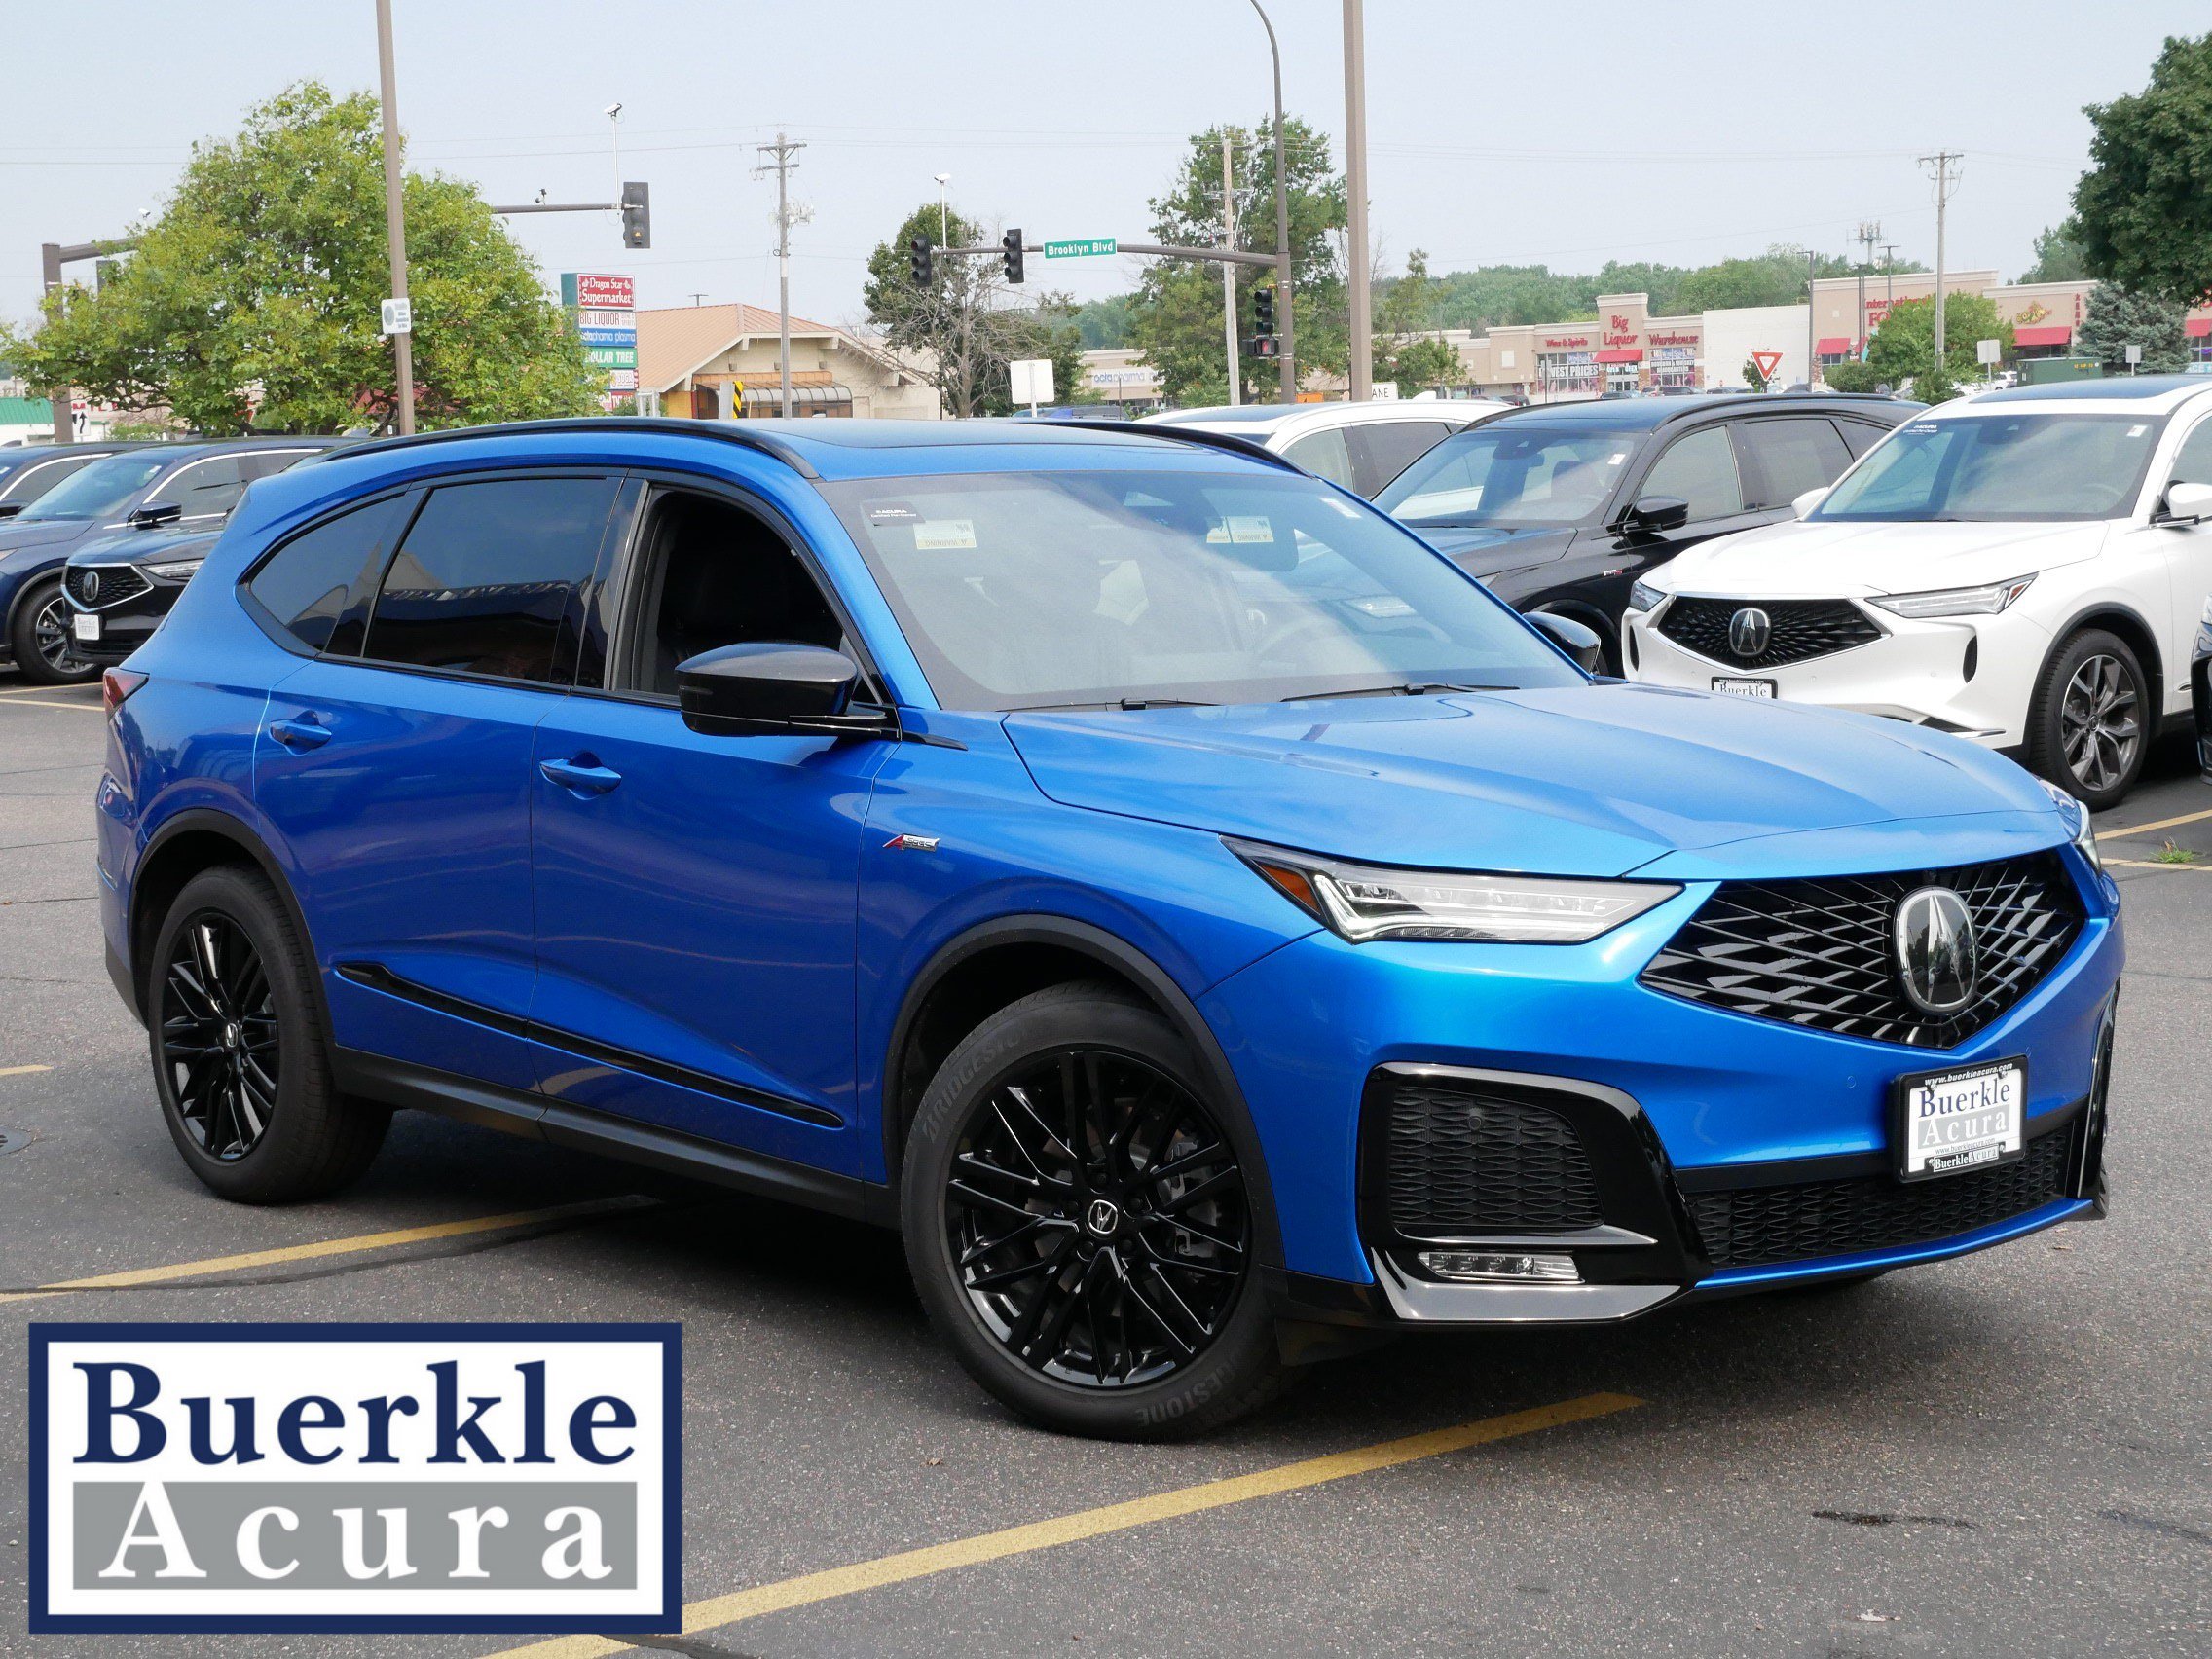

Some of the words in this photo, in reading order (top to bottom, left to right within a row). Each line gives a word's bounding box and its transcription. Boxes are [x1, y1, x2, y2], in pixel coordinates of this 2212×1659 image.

[1048, 243, 1088, 256] Brooklyn
[1092, 241, 1113, 253] Blvd
[589, 277, 610, 290] Dragon
[611, 278, 623, 289] Star
[582, 289, 632, 304] Supermarket
[579, 312, 592, 325] BIG
[594, 313, 620, 326] LIQUOR
[1611, 314, 1629, 333] Big
[1604, 331, 1638, 349] Liquor
[1648, 331, 1699, 345] Warehouse
[616, 351, 634, 363] TREE
[1569, 364, 1598, 377] PRICES
[1372, 388, 1389, 398] ANE
[1924, 1062, 2013, 1086] www.buerkleacura.com
[1918, 1077, 2010, 1119] Buerkle
[1922, 1111, 2007, 1147] Acura
[1935, 1137, 1996, 1156] www.buerkleacura.com
